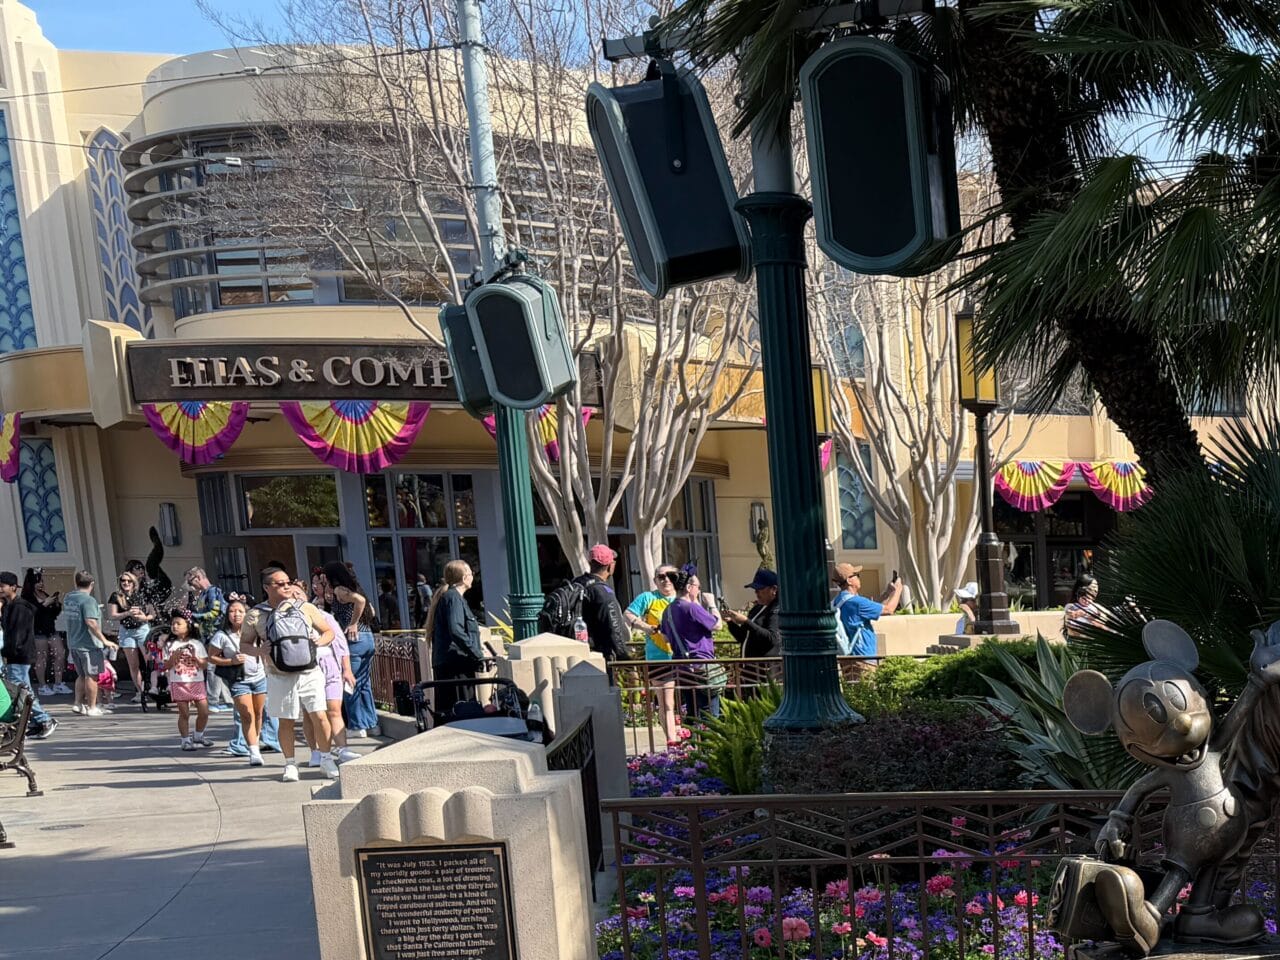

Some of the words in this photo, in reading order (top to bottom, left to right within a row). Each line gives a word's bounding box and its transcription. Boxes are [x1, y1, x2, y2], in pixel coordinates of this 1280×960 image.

[168, 356, 280, 388] ELIAS
[288, 359, 315, 382] &
[322, 356, 454, 388] COMP
